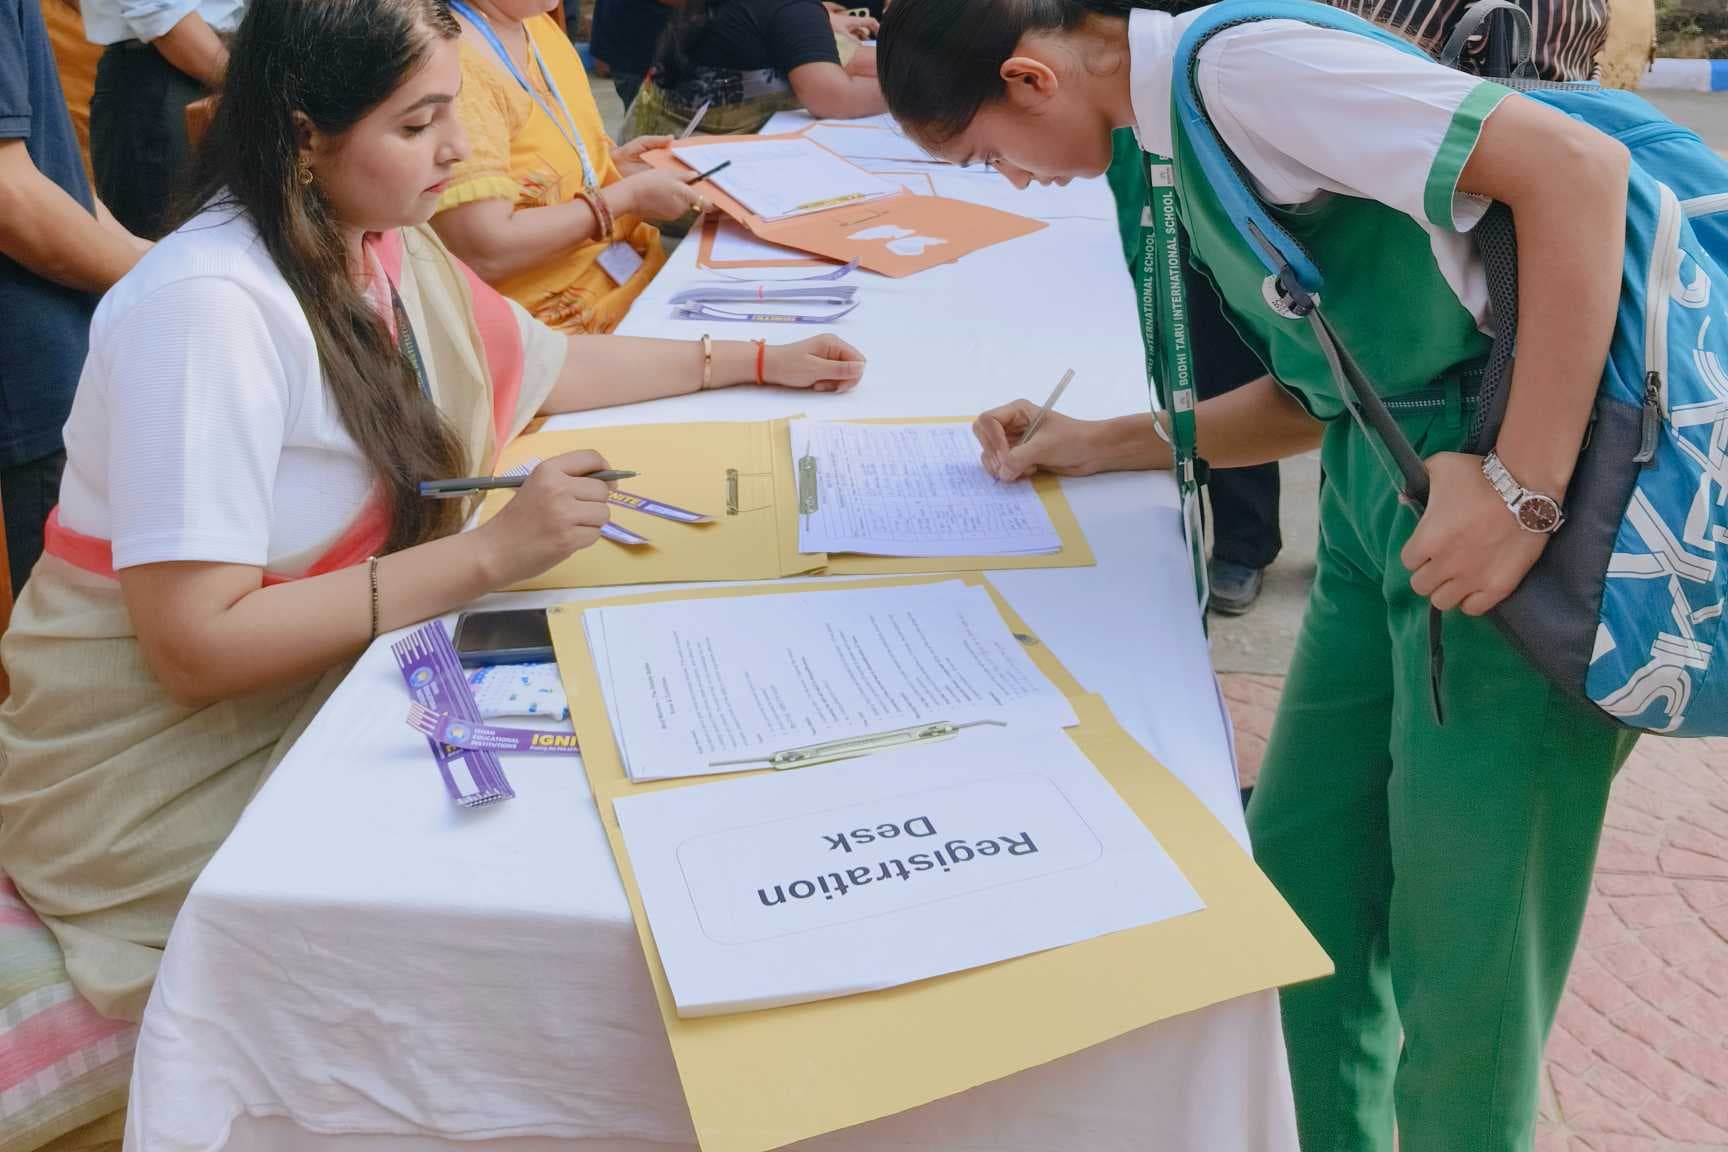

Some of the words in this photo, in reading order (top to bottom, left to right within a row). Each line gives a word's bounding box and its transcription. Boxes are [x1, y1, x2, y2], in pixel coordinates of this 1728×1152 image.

[1162, 191, 1176, 234] SCHOOL
[1143, 232, 1155, 273] SCHOOL
[1167, 237, 1184, 321] INTERNATIONAL
[1173, 324, 1185, 351] TARU
[1176, 353, 1189, 386] BODHI
[821, 815, 937, 853] Desk
[757, 831, 1039, 906] Registration
